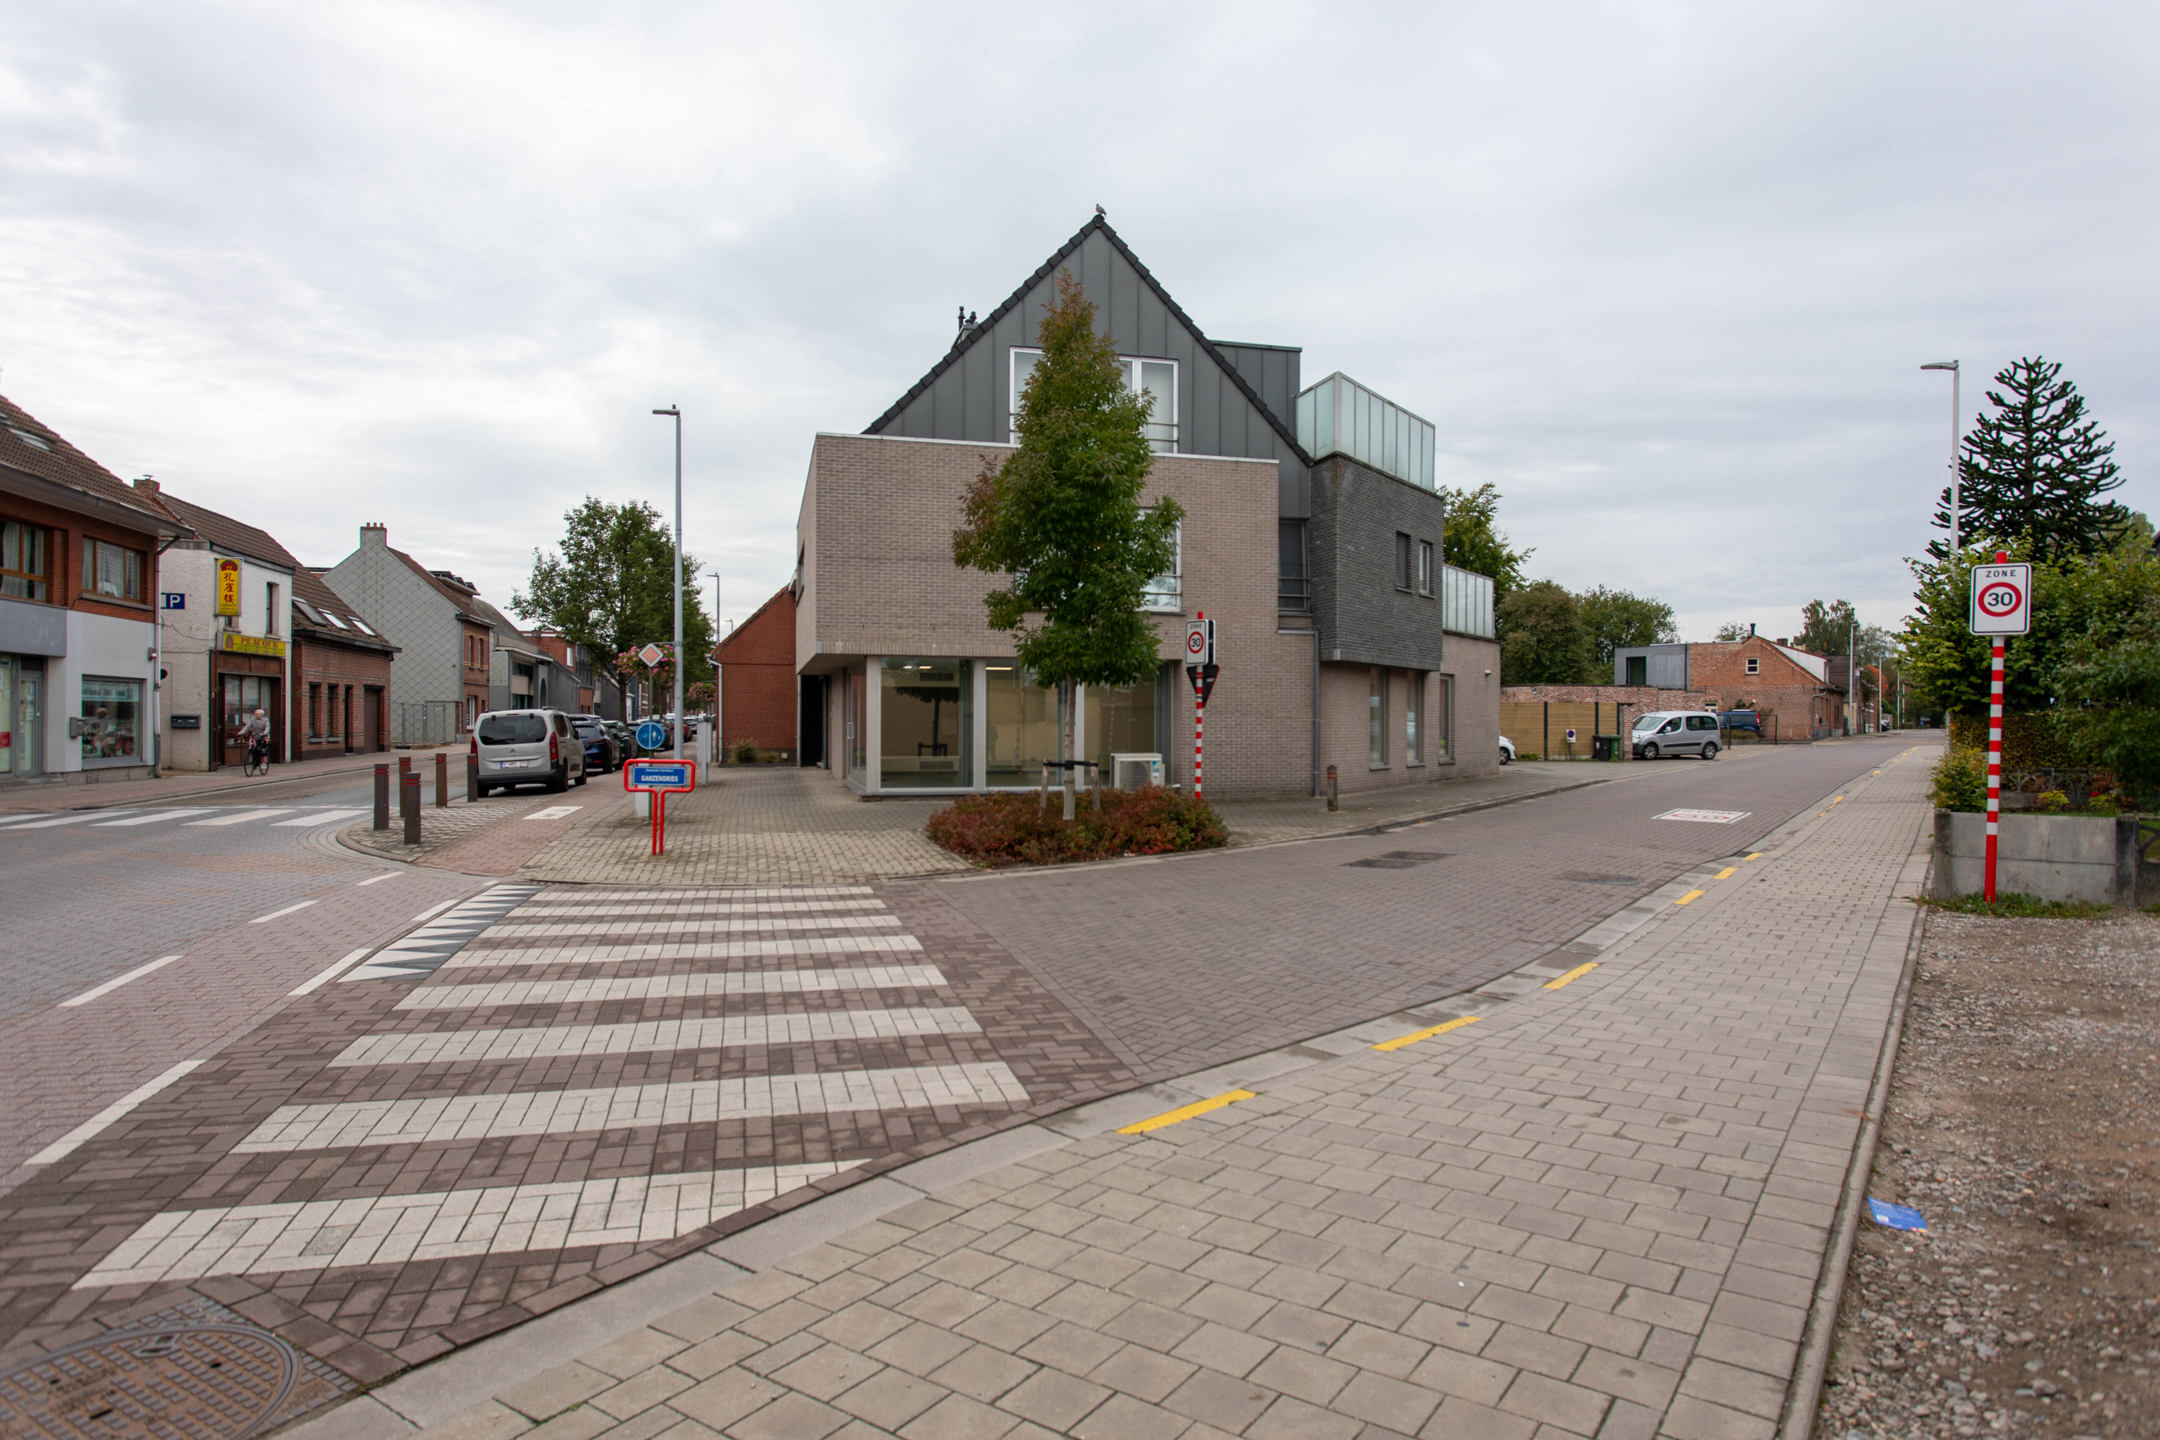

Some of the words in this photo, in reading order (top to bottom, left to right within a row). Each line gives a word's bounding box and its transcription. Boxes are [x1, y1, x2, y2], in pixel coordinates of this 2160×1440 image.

[1986, 569, 2016, 578] ZONE
[169, 594, 181, 608] P
[1987, 592, 2014, 606] 30
[240, 636, 279, 648] PEACOCK
[1191, 637, 1201, 647] 30
